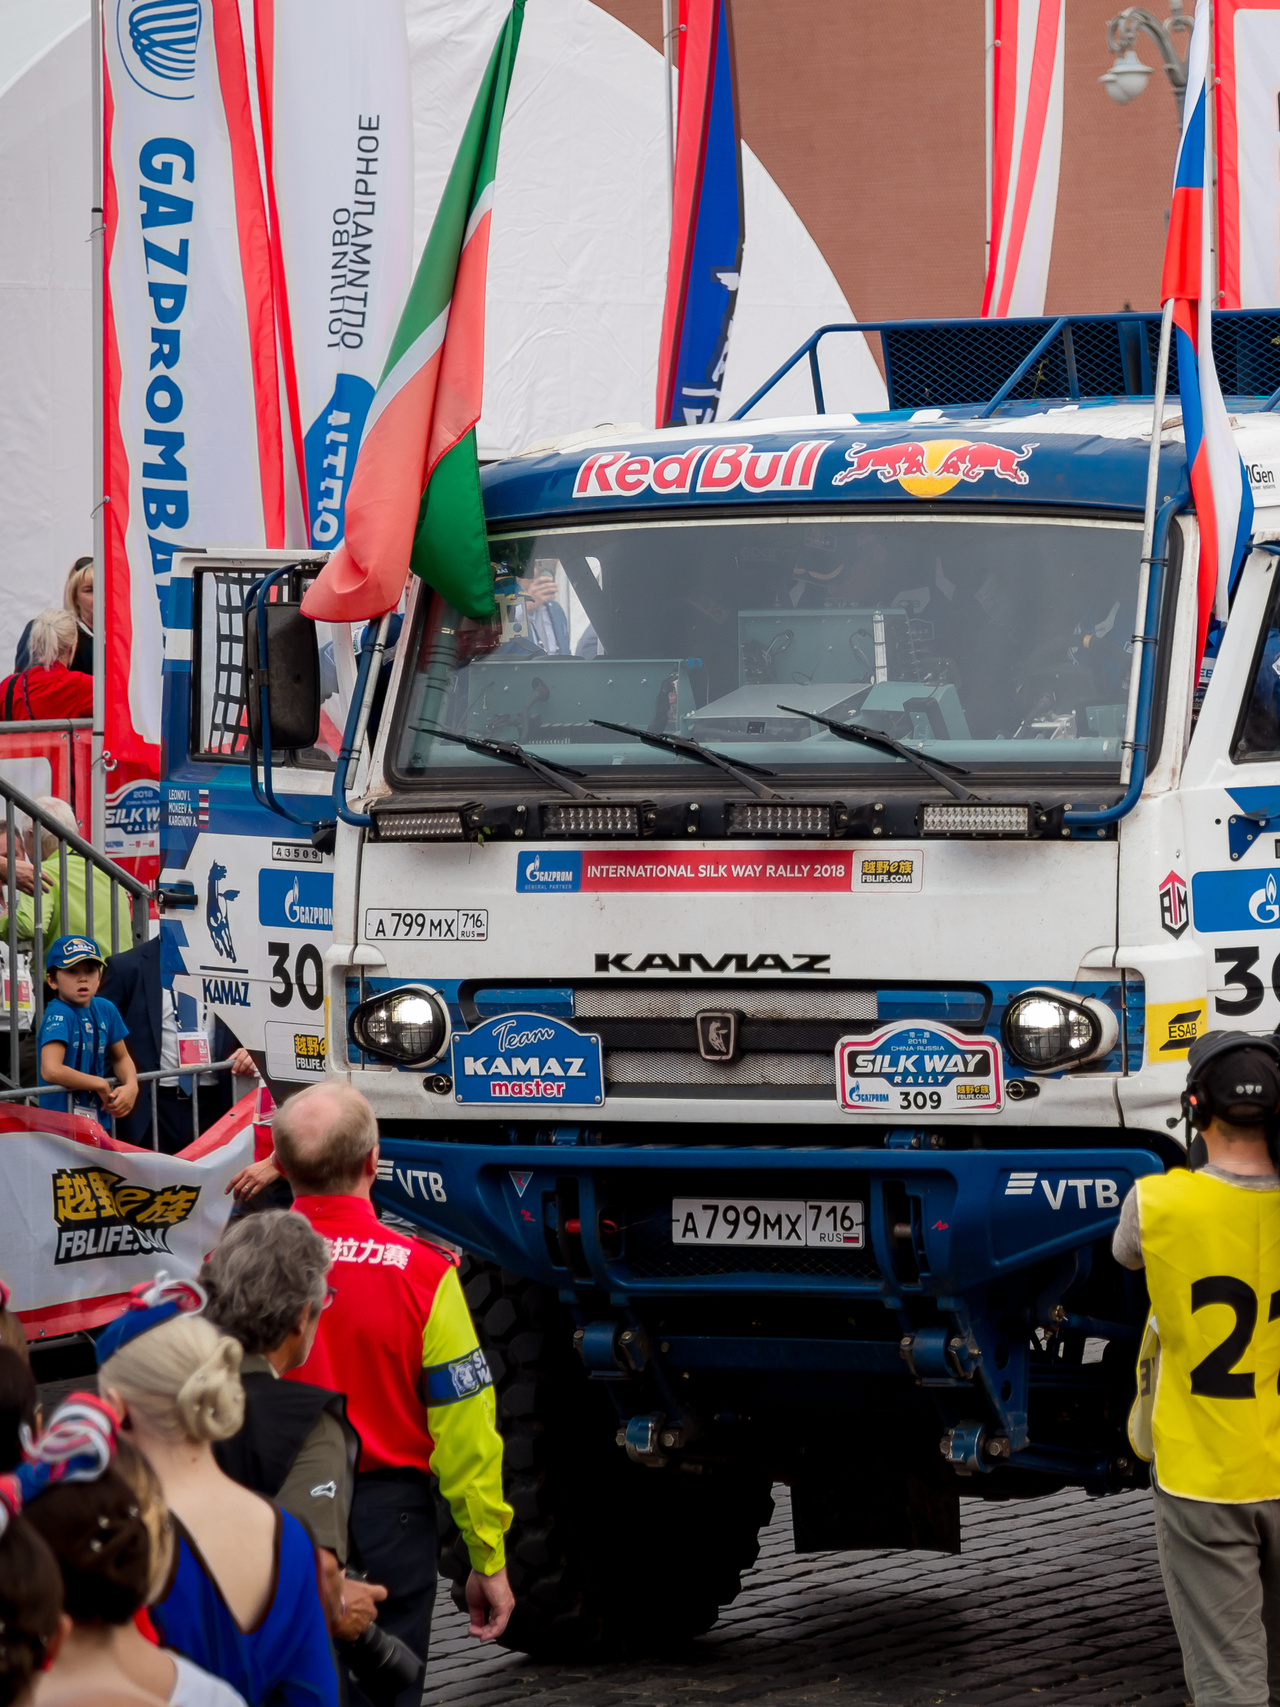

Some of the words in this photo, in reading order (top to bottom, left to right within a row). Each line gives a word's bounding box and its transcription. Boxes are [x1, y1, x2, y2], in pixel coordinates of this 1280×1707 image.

[574, 446, 706, 497] Red
[699, 440, 832, 493] Bull
[105, 808, 144, 824] SILK
[276, 847, 318, 859] 43509
[539, 871, 572, 882] GAZPROM
[587, 865, 694, 877] INTERNATIONAL
[698, 865, 727, 877] SILK
[731, 865, 762, 877] WAY
[766, 865, 810, 877] RALLY
[813, 864, 845, 877] 2018
[862, 874, 912, 883] FBLIFE.COM
[462, 913, 482, 928] 716
[461, 930, 475, 938] RUS
[595, 953, 831, 975] KAMAZ
[202, 978, 251, 1007] KAMAZ
[493, 1020, 554, 1051] Team
[1169, 1021, 1198, 1039] ESAB
[464, 1057, 586, 1076] KAMAZ
[854, 1054, 917, 1073] SILK
[924, 1054, 983, 1073] WAY
[490, 1078, 565, 1098] master
[861, 1093, 889, 1103] GAZPROM
[900, 1091, 941, 1110] 309
[396, 1168, 447, 1203] VTB
[1040, 1178, 1120, 1210] VTB
[809, 1204, 855, 1232] 716
[819, 1232, 843, 1243] RUS
